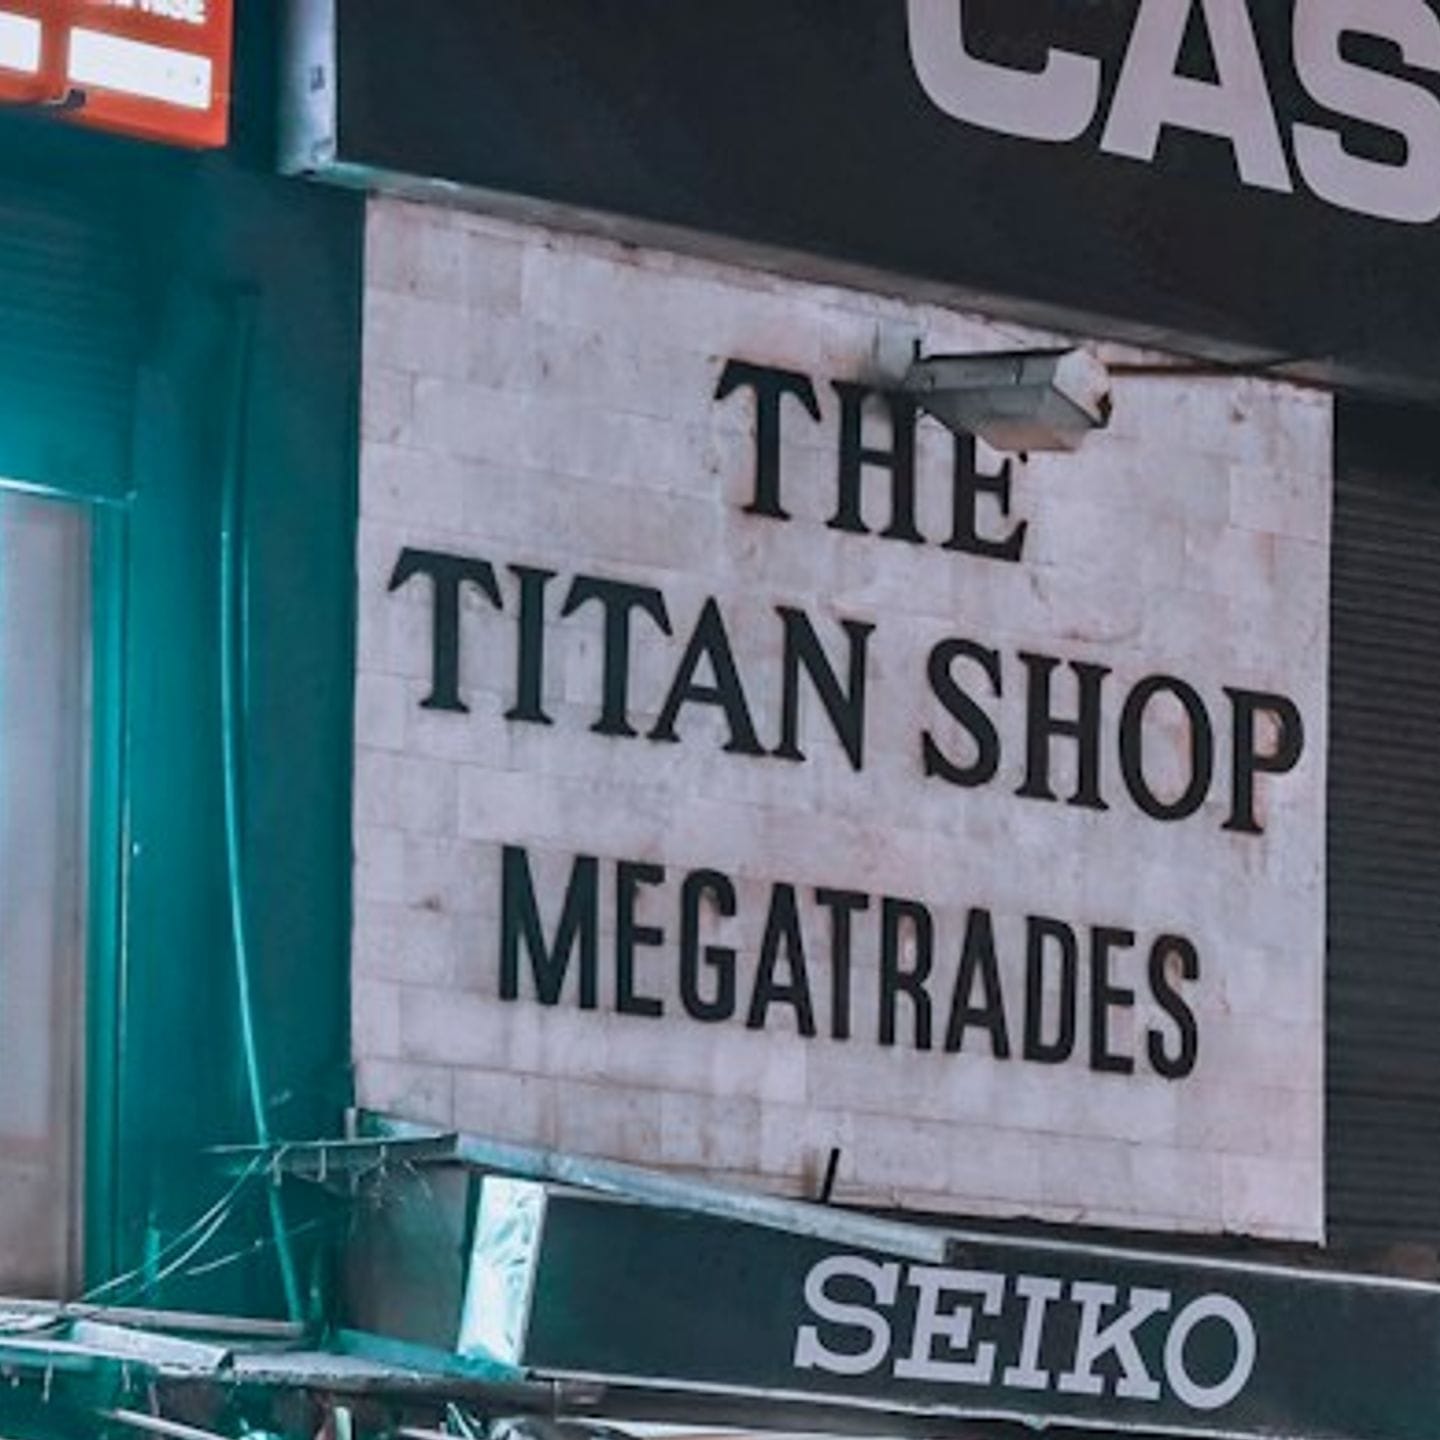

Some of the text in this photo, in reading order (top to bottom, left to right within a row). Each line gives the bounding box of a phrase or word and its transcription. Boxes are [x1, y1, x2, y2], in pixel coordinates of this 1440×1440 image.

[712, 358, 1029, 562] THE
[387, 546, 1304, 835] TITAN SHOP
[498, 845, 1201, 1080] MEGATRADES
[794, 1255, 1256, 1410] SEIKO
